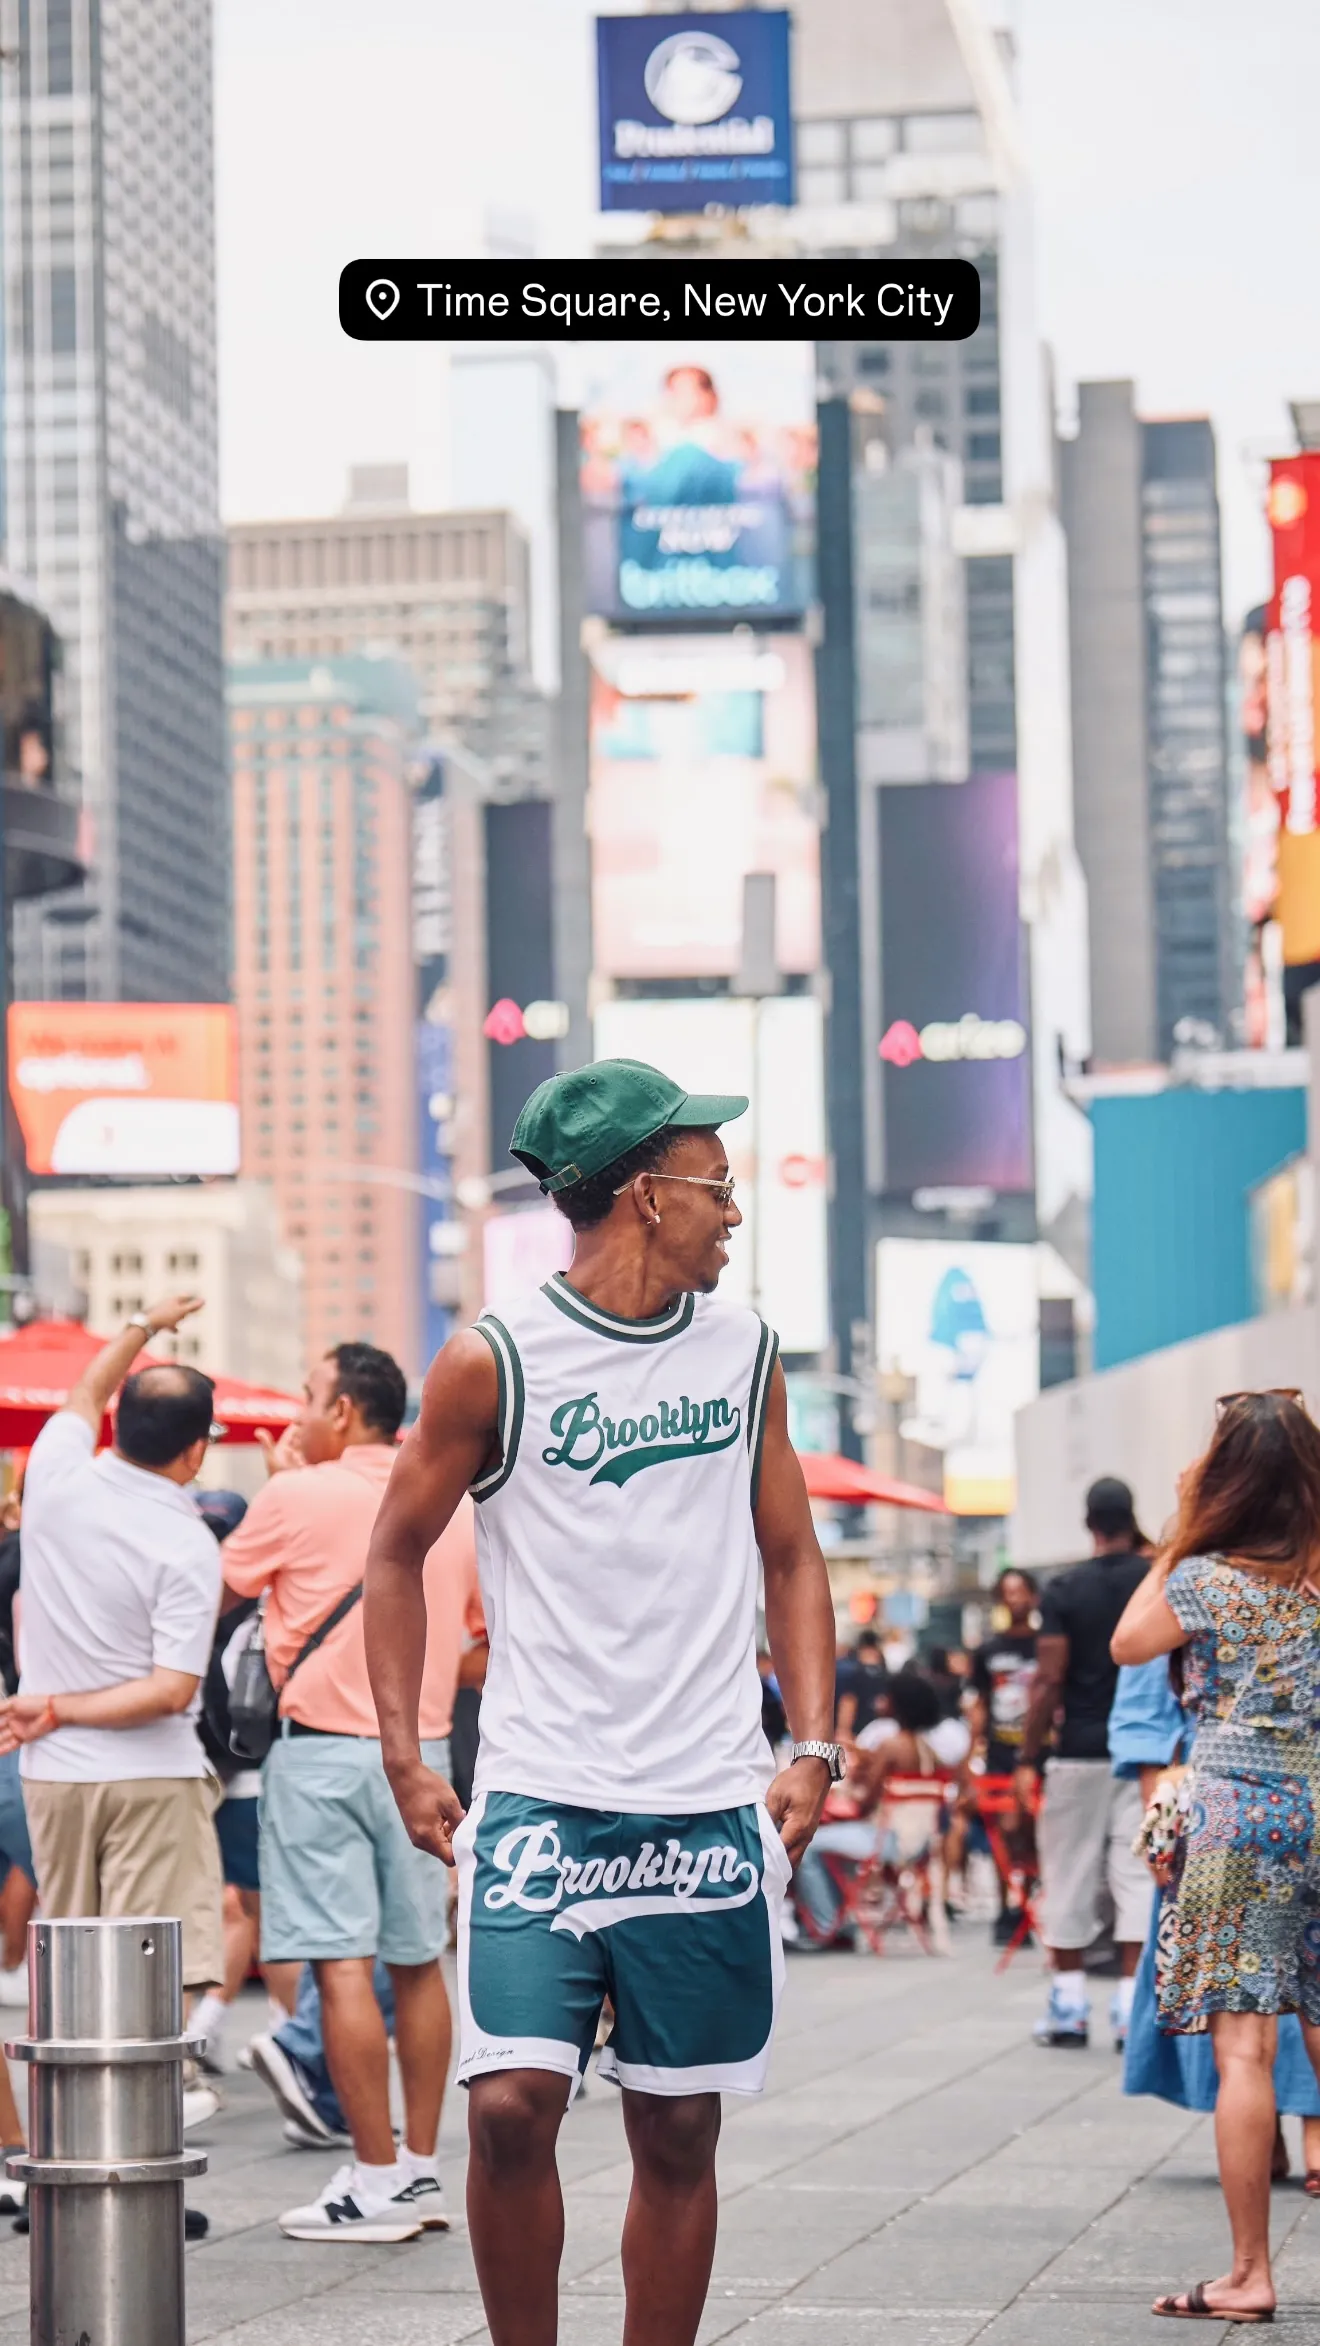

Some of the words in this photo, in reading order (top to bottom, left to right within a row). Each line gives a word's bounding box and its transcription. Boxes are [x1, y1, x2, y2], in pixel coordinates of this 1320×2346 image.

[542, 1392, 741, 1472] Brooklyn
[483, 1820, 758, 1912] Brooklyn
[476, 2047, 514, 2060] Design
